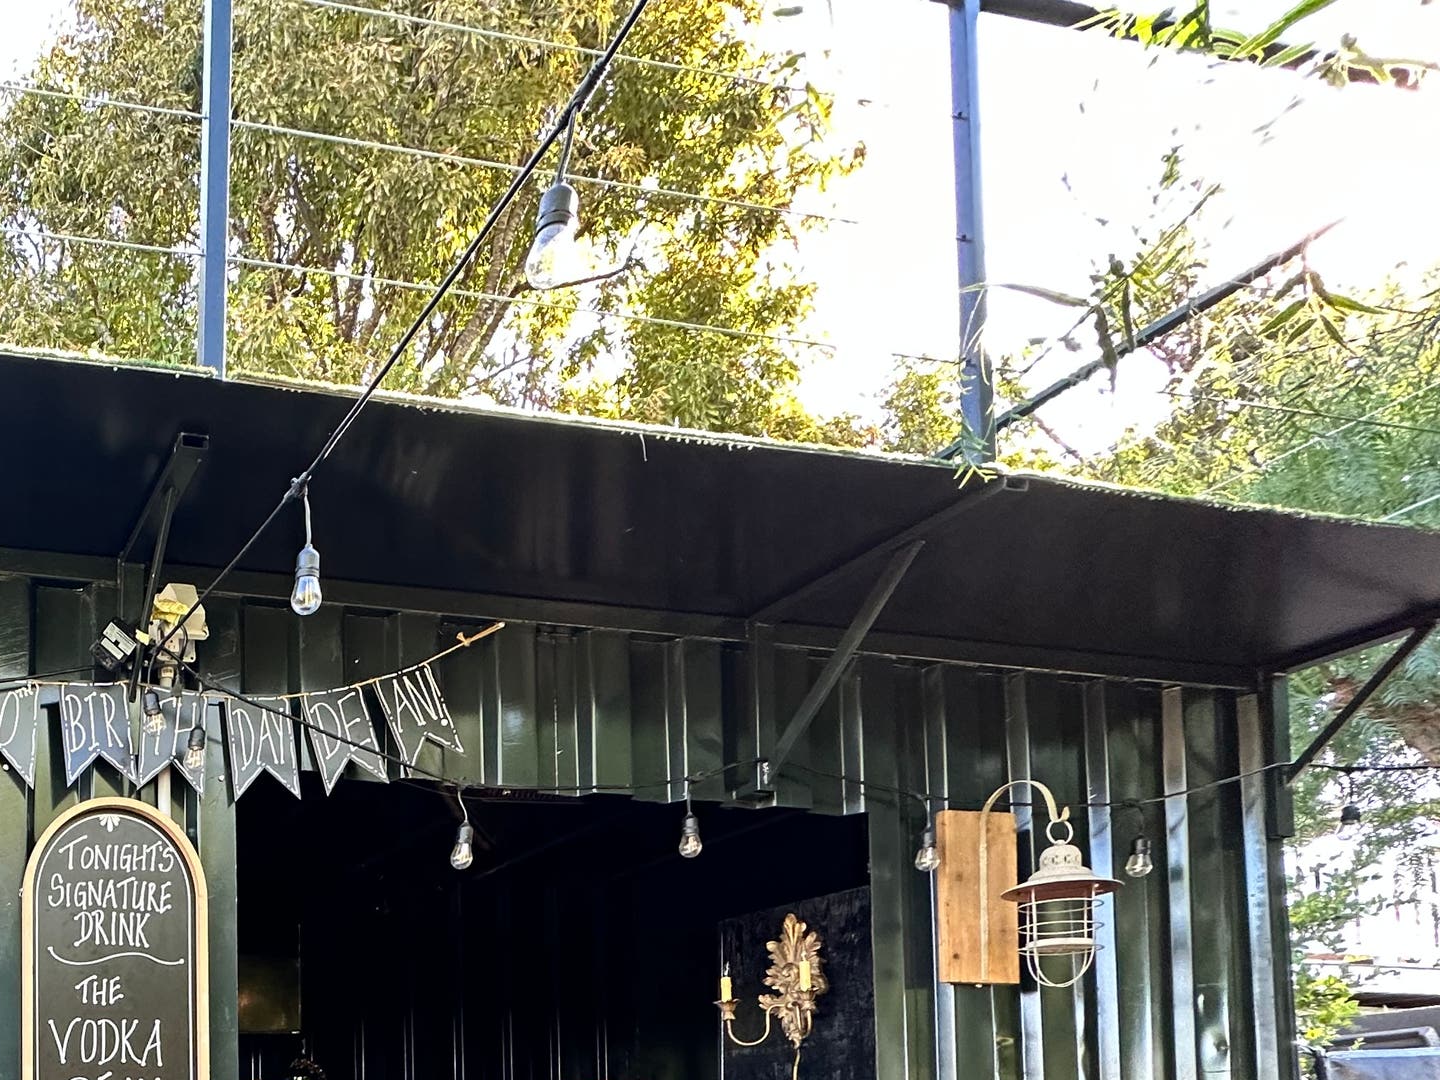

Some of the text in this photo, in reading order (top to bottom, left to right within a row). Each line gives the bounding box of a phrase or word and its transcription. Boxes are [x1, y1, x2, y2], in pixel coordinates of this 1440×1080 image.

[59, 835, 175, 873] TONIGHT'S
[47, 873, 173, 914] SIGNATURE
[73, 909, 151, 948] DRINK
[75, 974, 125, 1007] THE
[48, 1017, 164, 1068] VODKA
